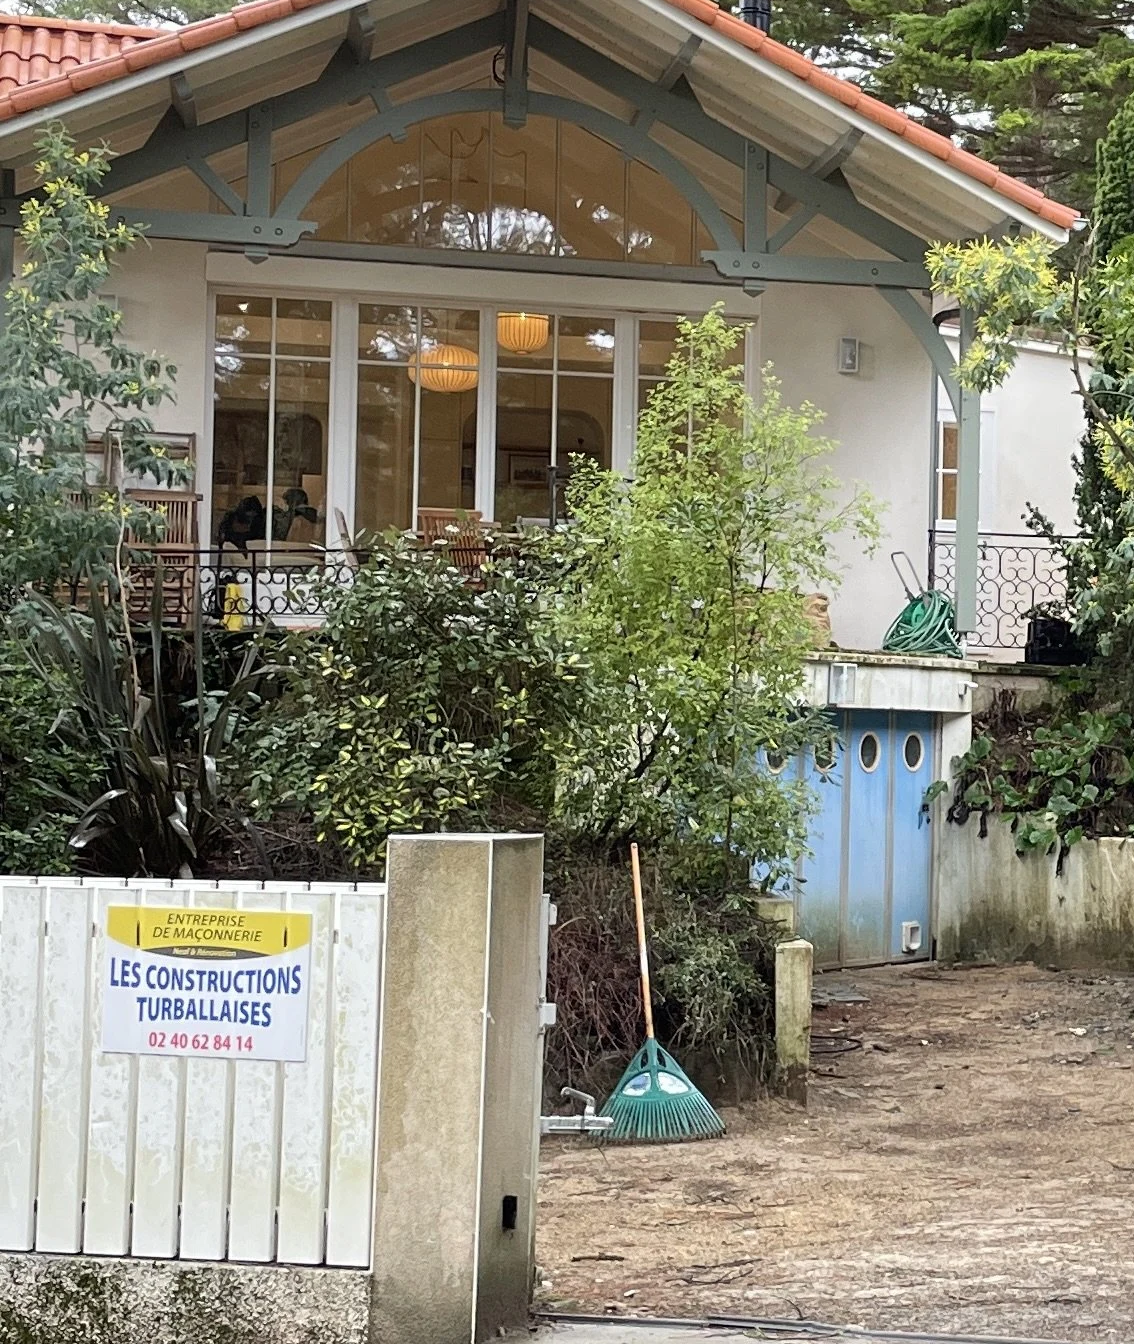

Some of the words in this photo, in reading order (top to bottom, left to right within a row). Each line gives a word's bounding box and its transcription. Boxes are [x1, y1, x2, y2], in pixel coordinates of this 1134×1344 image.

[167, 913, 246, 927] ENTREPRISE
[152, 926, 170, 938] DE
[173, 928, 262, 942] MAÇONNERIE
[110, 957, 141, 988] LES
[146, 964, 301, 995] CONSTRUCTIONS
[136, 997, 272, 1027] TURBALLAISES
[149, 1032, 166, 1048] 02
[170, 1033, 188, 1049] 40
[191, 1034, 209, 1050] 62
[213, 1035, 231, 1051] 84
[236, 1035, 253, 1052] 14
